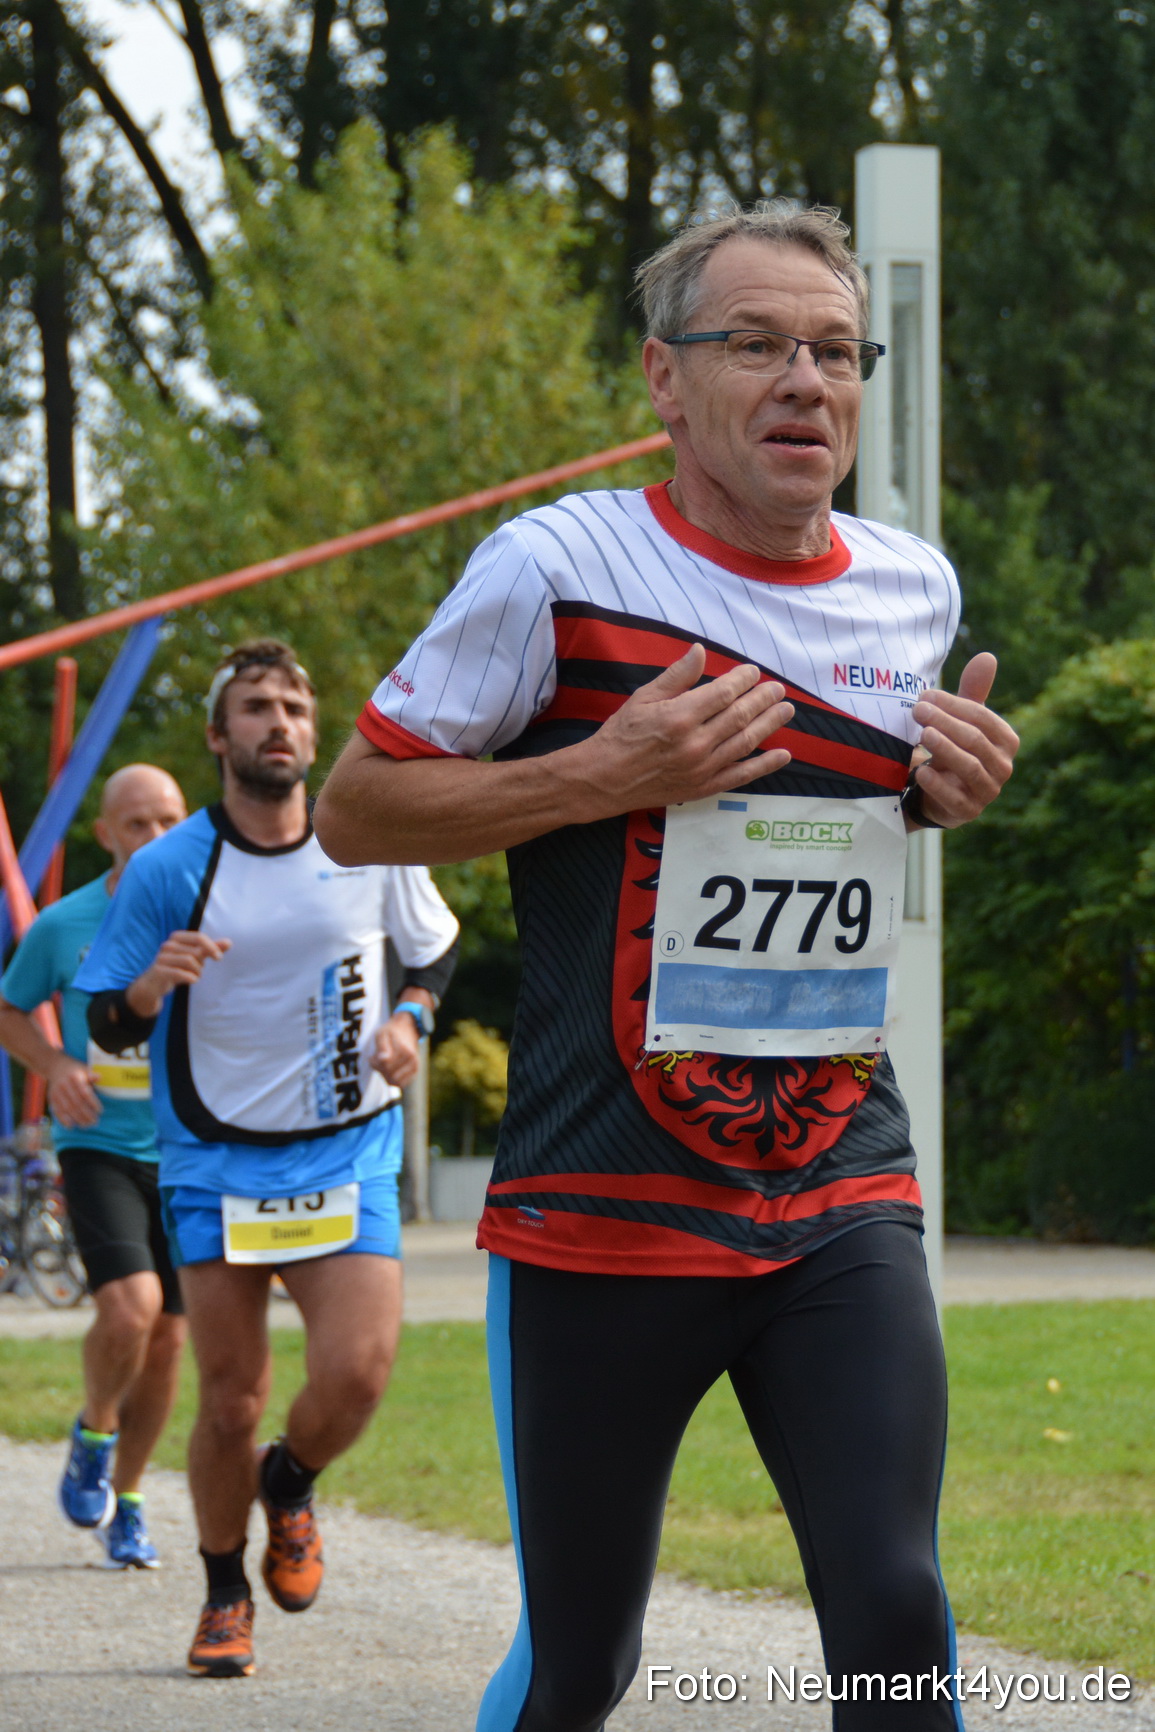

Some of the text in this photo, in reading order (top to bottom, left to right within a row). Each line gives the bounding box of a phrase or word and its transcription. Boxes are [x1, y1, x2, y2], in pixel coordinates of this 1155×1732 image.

[771, 821, 853, 843] BOCK
[769, 843, 795, 851] inspired
[796, 843, 804, 852] by
[693, 875, 872, 954] 2779
[666, 937, 676, 951] D
[332, 955, 366, 1116] HUBER
